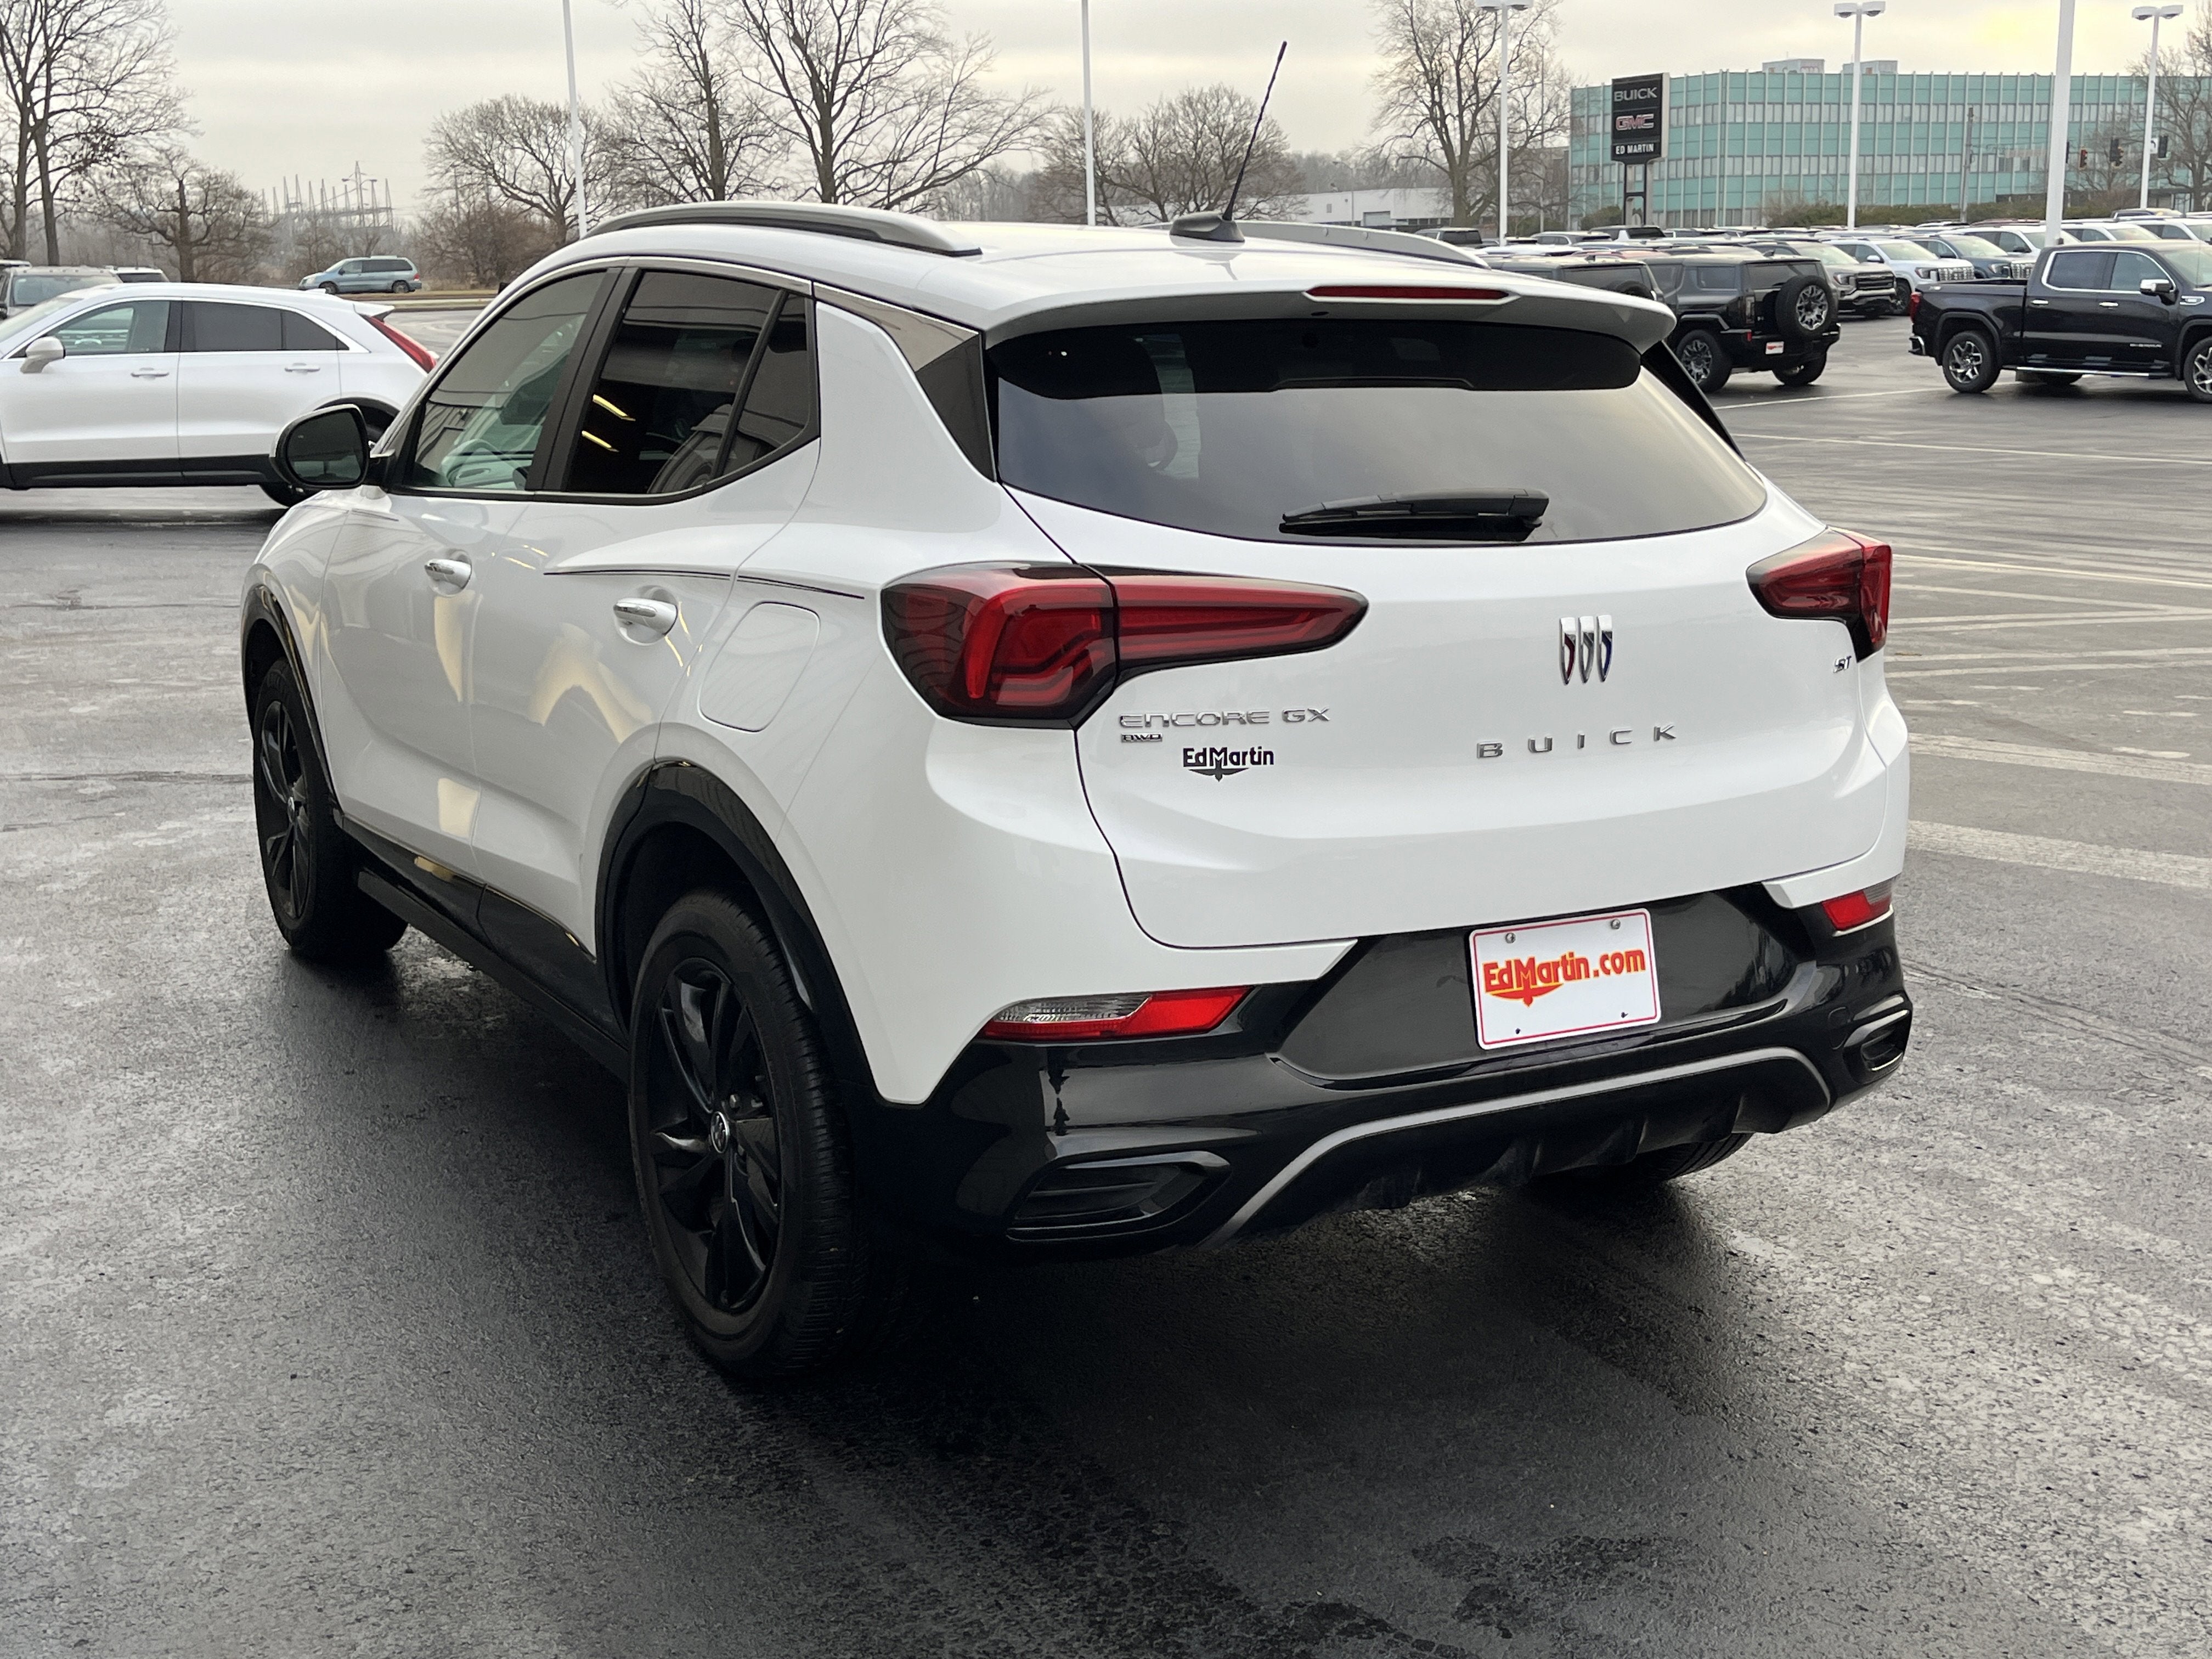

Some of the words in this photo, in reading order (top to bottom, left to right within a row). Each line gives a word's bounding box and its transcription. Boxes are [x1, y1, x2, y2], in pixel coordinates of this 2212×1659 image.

[1613, 87, 1657, 102] BUICK
[1616, 114, 1654, 131] GMC
[1615, 145, 1625, 155] ED
[1627, 143, 1654, 154] MARTIN
[1120, 709, 1270, 728] ENCORE
[1282, 707, 1331, 723] GX
[1476, 725, 1676, 759] BUICK
[1482, 949, 1646, 995] EdMartin.com
